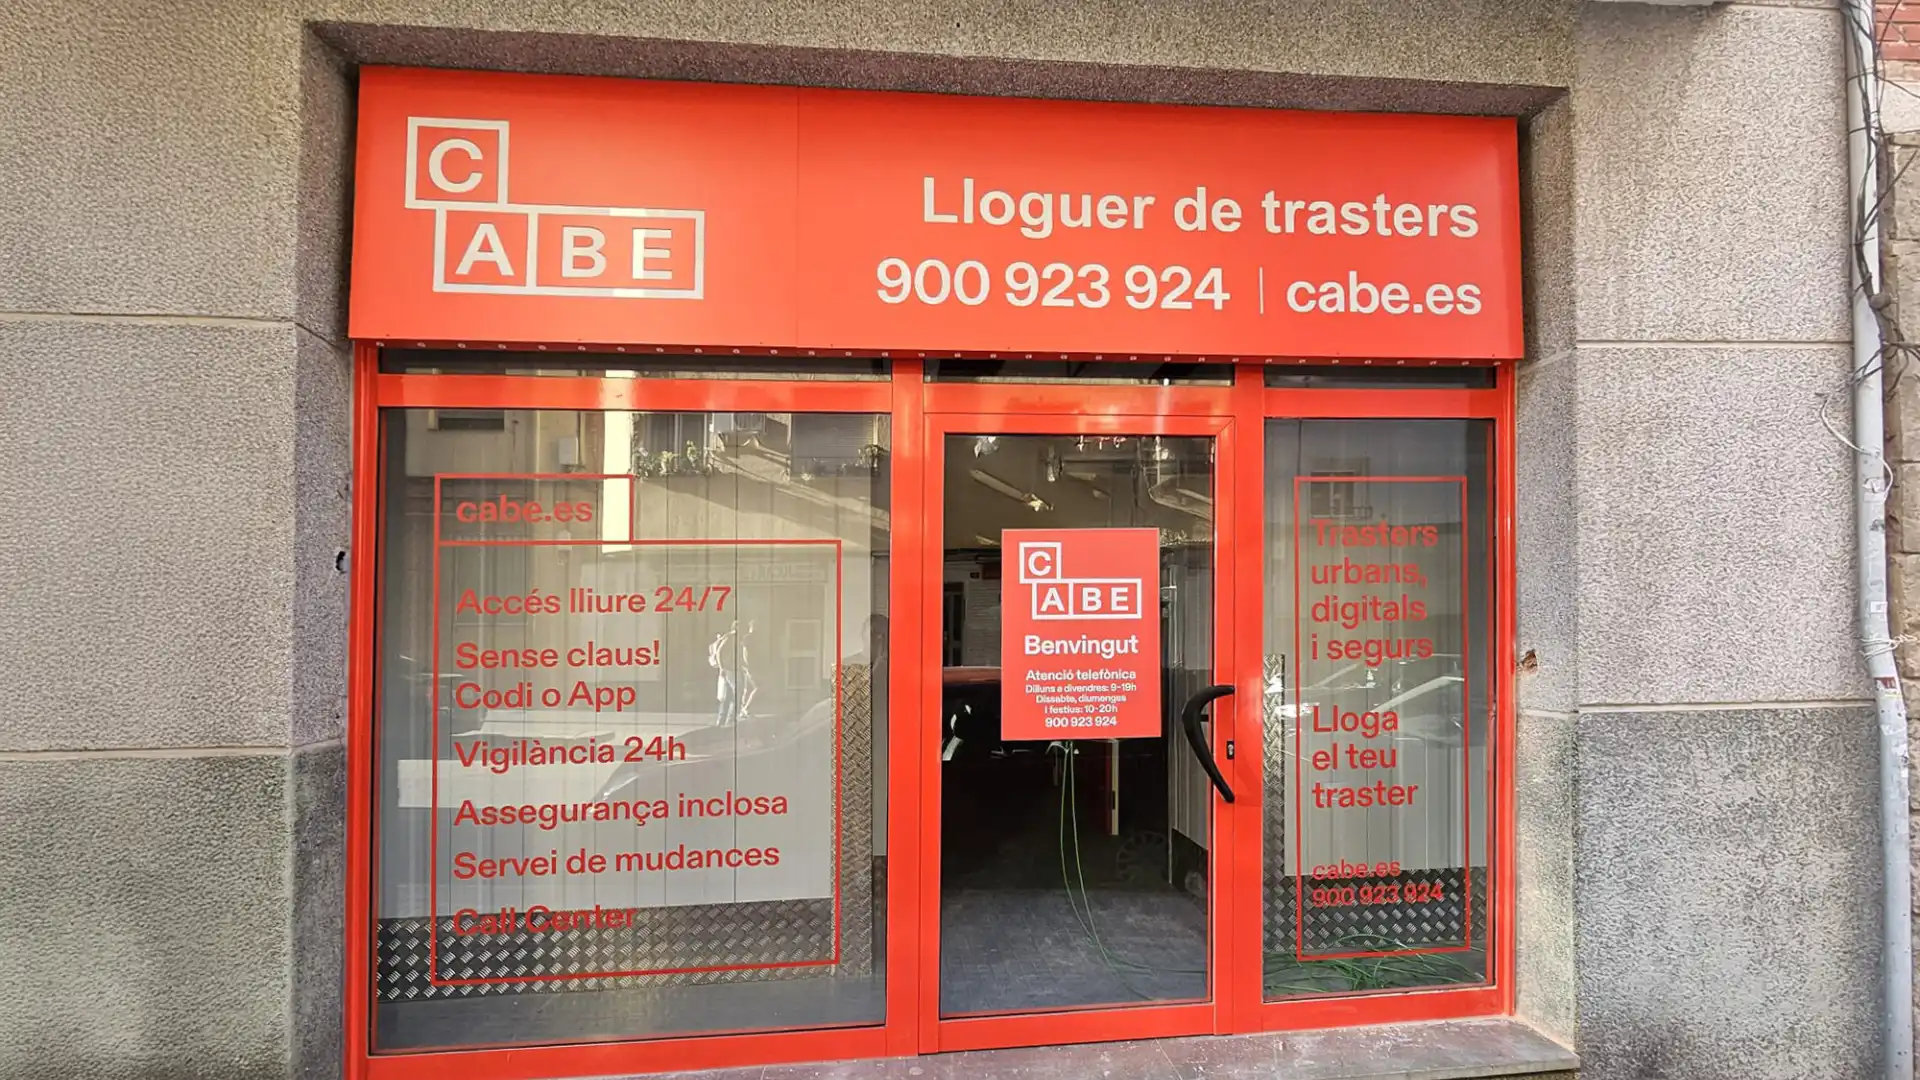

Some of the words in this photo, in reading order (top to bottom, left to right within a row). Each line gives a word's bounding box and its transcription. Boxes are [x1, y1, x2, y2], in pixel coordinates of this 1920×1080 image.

[923, 176, 1155, 239] Lloguer
[1174, 187, 1242, 232] de
[1261, 190, 1479, 238] trasters
[876, 259, 990, 305] 900
[1005, 262, 1110, 308] 923
[1125, 265, 1230, 309] 924
[1286, 271, 1482, 315] cabe.es
[456, 495, 593, 523] cabe.es
[1310, 519, 1438, 547] Trasters
[1311, 558, 1427, 588] urbans,
[456, 588, 561, 615] Accés
[570, 588, 646, 613] lliure
[654, 586, 731, 613] 24/7
[1311, 594, 1427, 629] digitals
[456, 642, 558, 669] Sense
[566, 640, 660, 666] claus!
[1024, 635, 1139, 659] Benvingut
[1312, 633, 1318, 660] i
[1327, 637, 1433, 667] segurs
[1026, 669, 1073, 681] Atenció
[1077, 669, 1136, 680] telefònica
[1026, 684, 1055, 693] Dilluns
[1111, 683, 1136, 692] 9-19h
[455, 682, 533, 709] Codi
[541, 688, 560, 707] o
[568, 681, 636, 711] App
[1084, 705, 1118, 713] 10-20h
[1045, 717, 1068, 728] 900
[1071, 717, 1092, 727] 923
[1095, 716, 1117, 726] 924
[1313, 705, 1398, 738] Lloga
[454, 740, 615, 774] Vigilància
[624, 736, 686, 762] 24h
[1312, 743, 1338, 770] el
[1346, 744, 1396, 769] teu
[1312, 781, 1418, 808] traster
[454, 798, 669, 830] Assegurança
[678, 792, 788, 818] inclosa
[453, 848, 557, 879] Servei
[566, 848, 607, 874] de
[616, 843, 780, 872] mudances
[1312, 860, 1400, 880] cabe.es
[1313, 888, 1354, 907] 900
[1360, 887, 1399, 905] 923
[1404, 885, 1444, 903] 924
[452, 907, 516, 936] Call
[525, 905, 637, 933] Center
